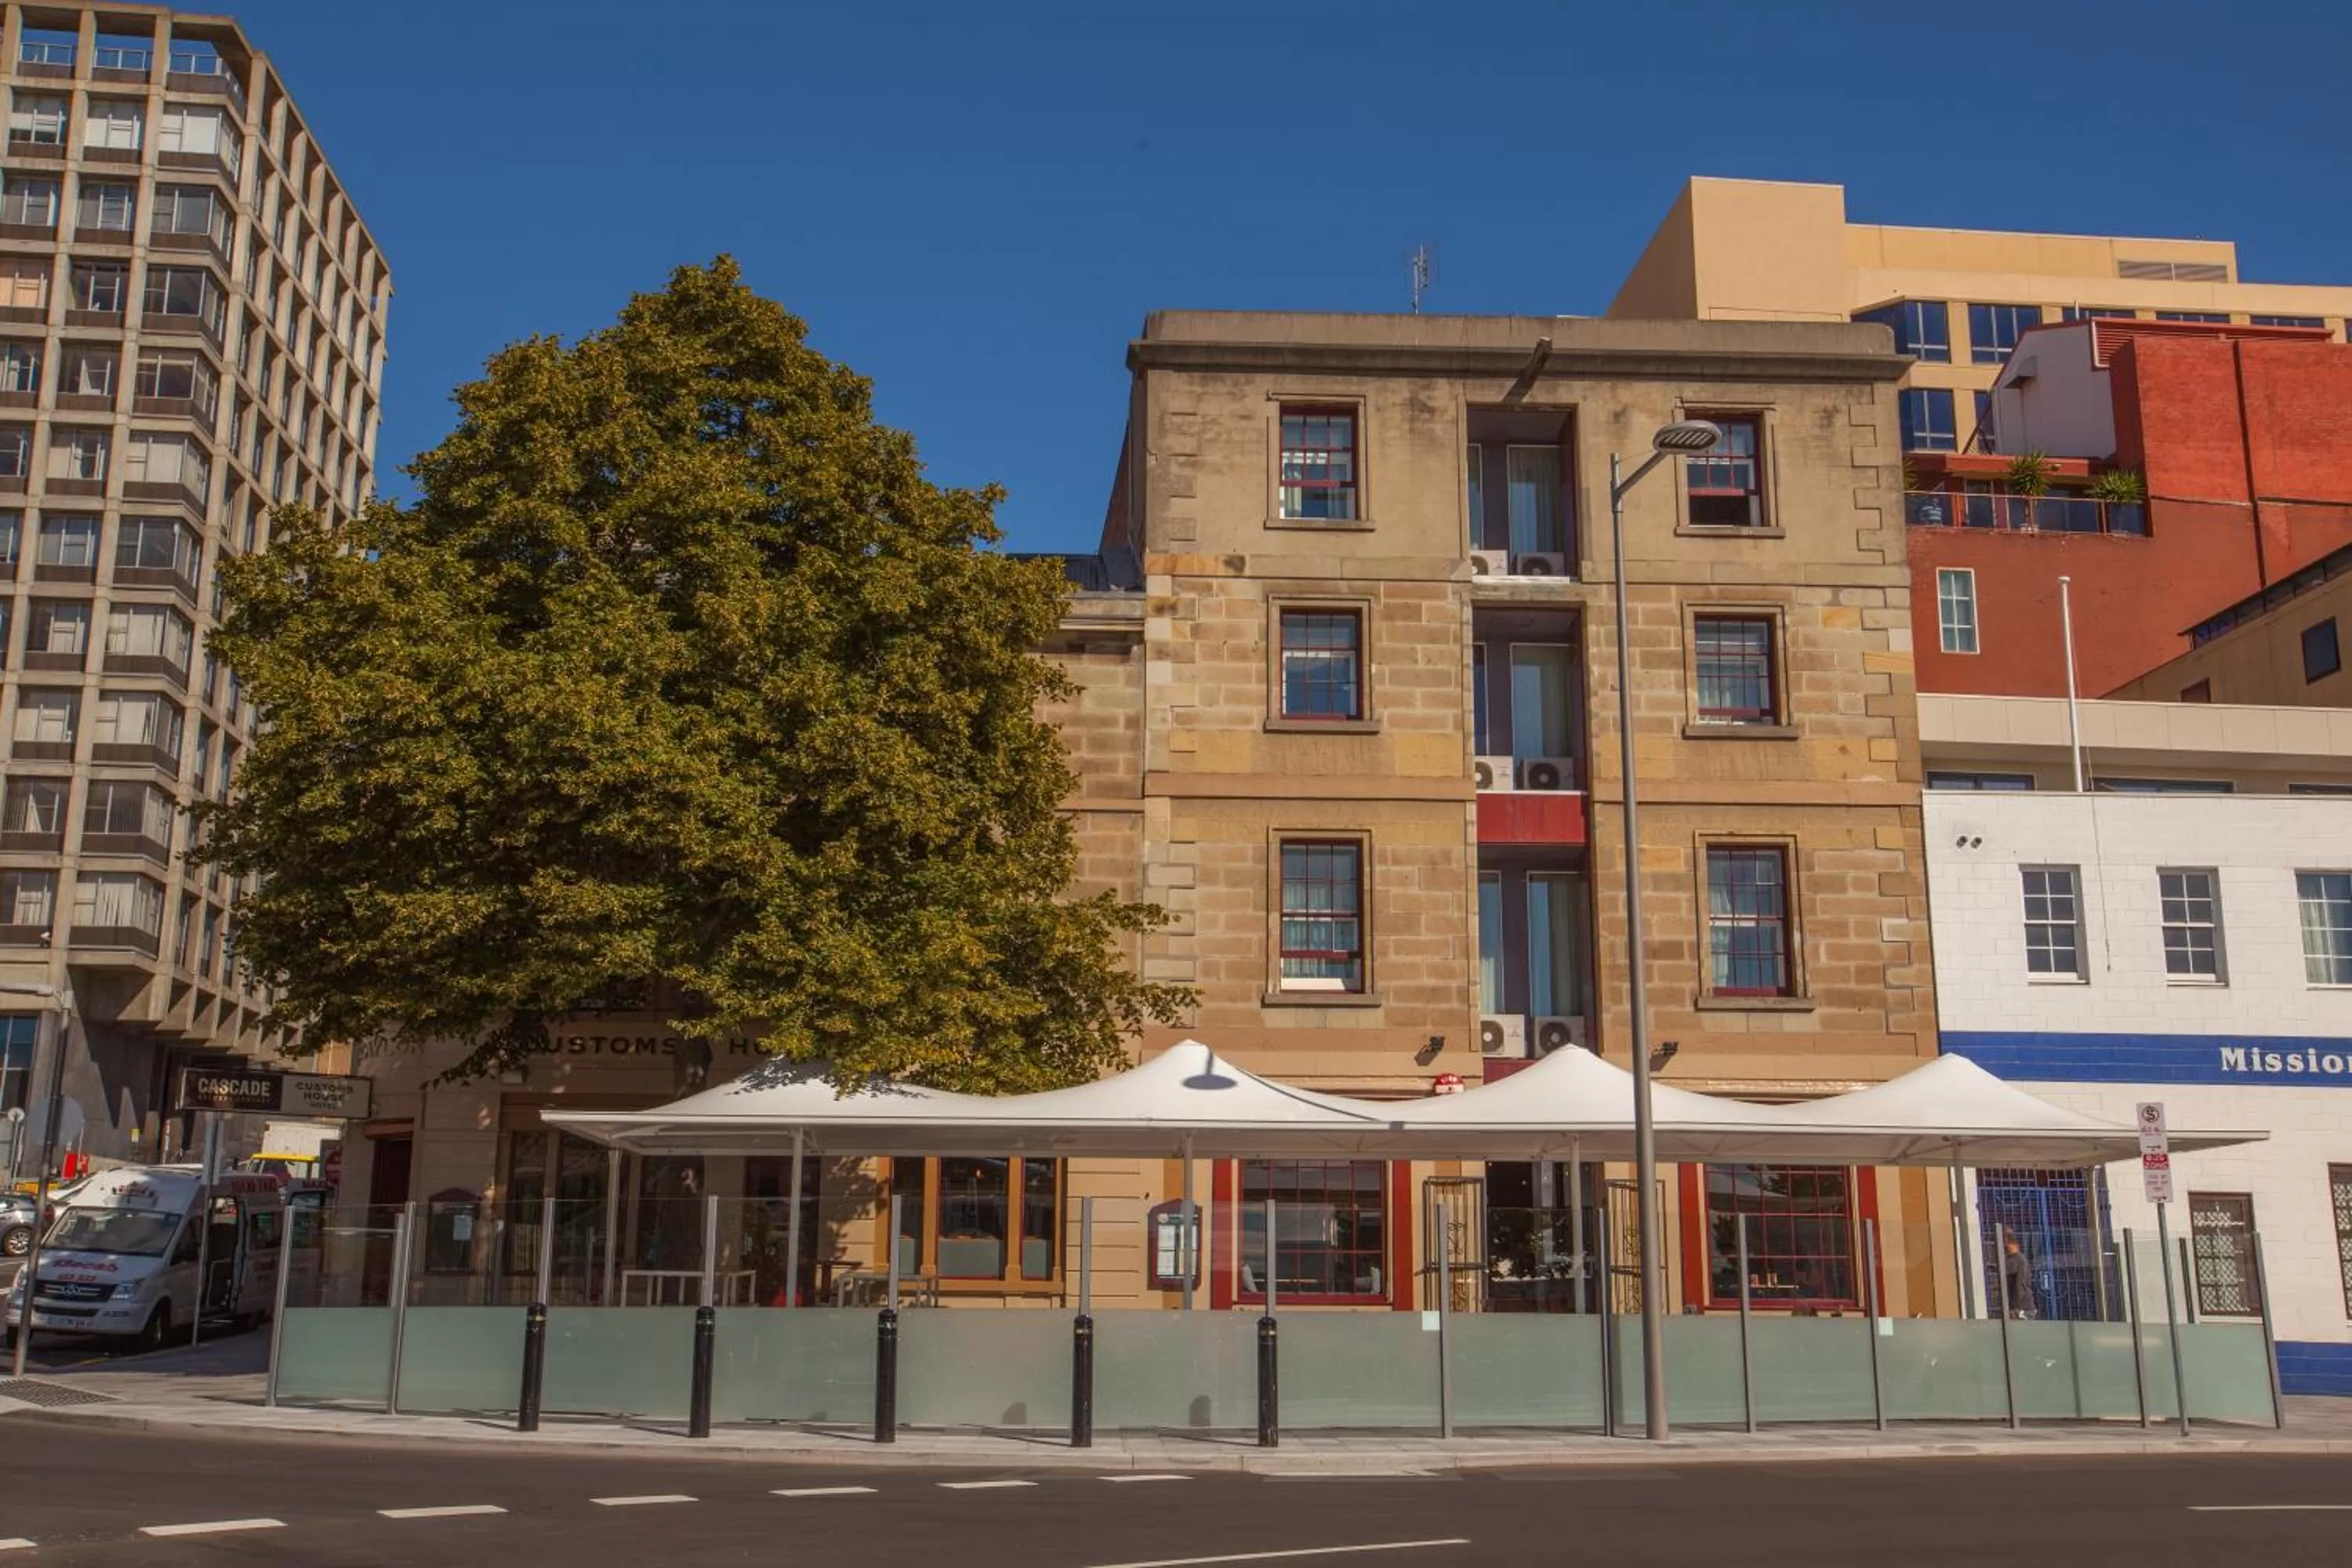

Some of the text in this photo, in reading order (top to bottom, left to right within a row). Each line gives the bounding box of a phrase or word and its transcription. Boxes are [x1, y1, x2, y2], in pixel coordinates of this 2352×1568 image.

[2220, 1047, 2352, 1073] Missio
[198, 1078, 270, 1097] CASCADE
[295, 1081, 354, 1094] CUSTOMS
[303, 1091, 345, 1102] HOUSE
[2145, 1153, 2165, 1162] BUS
